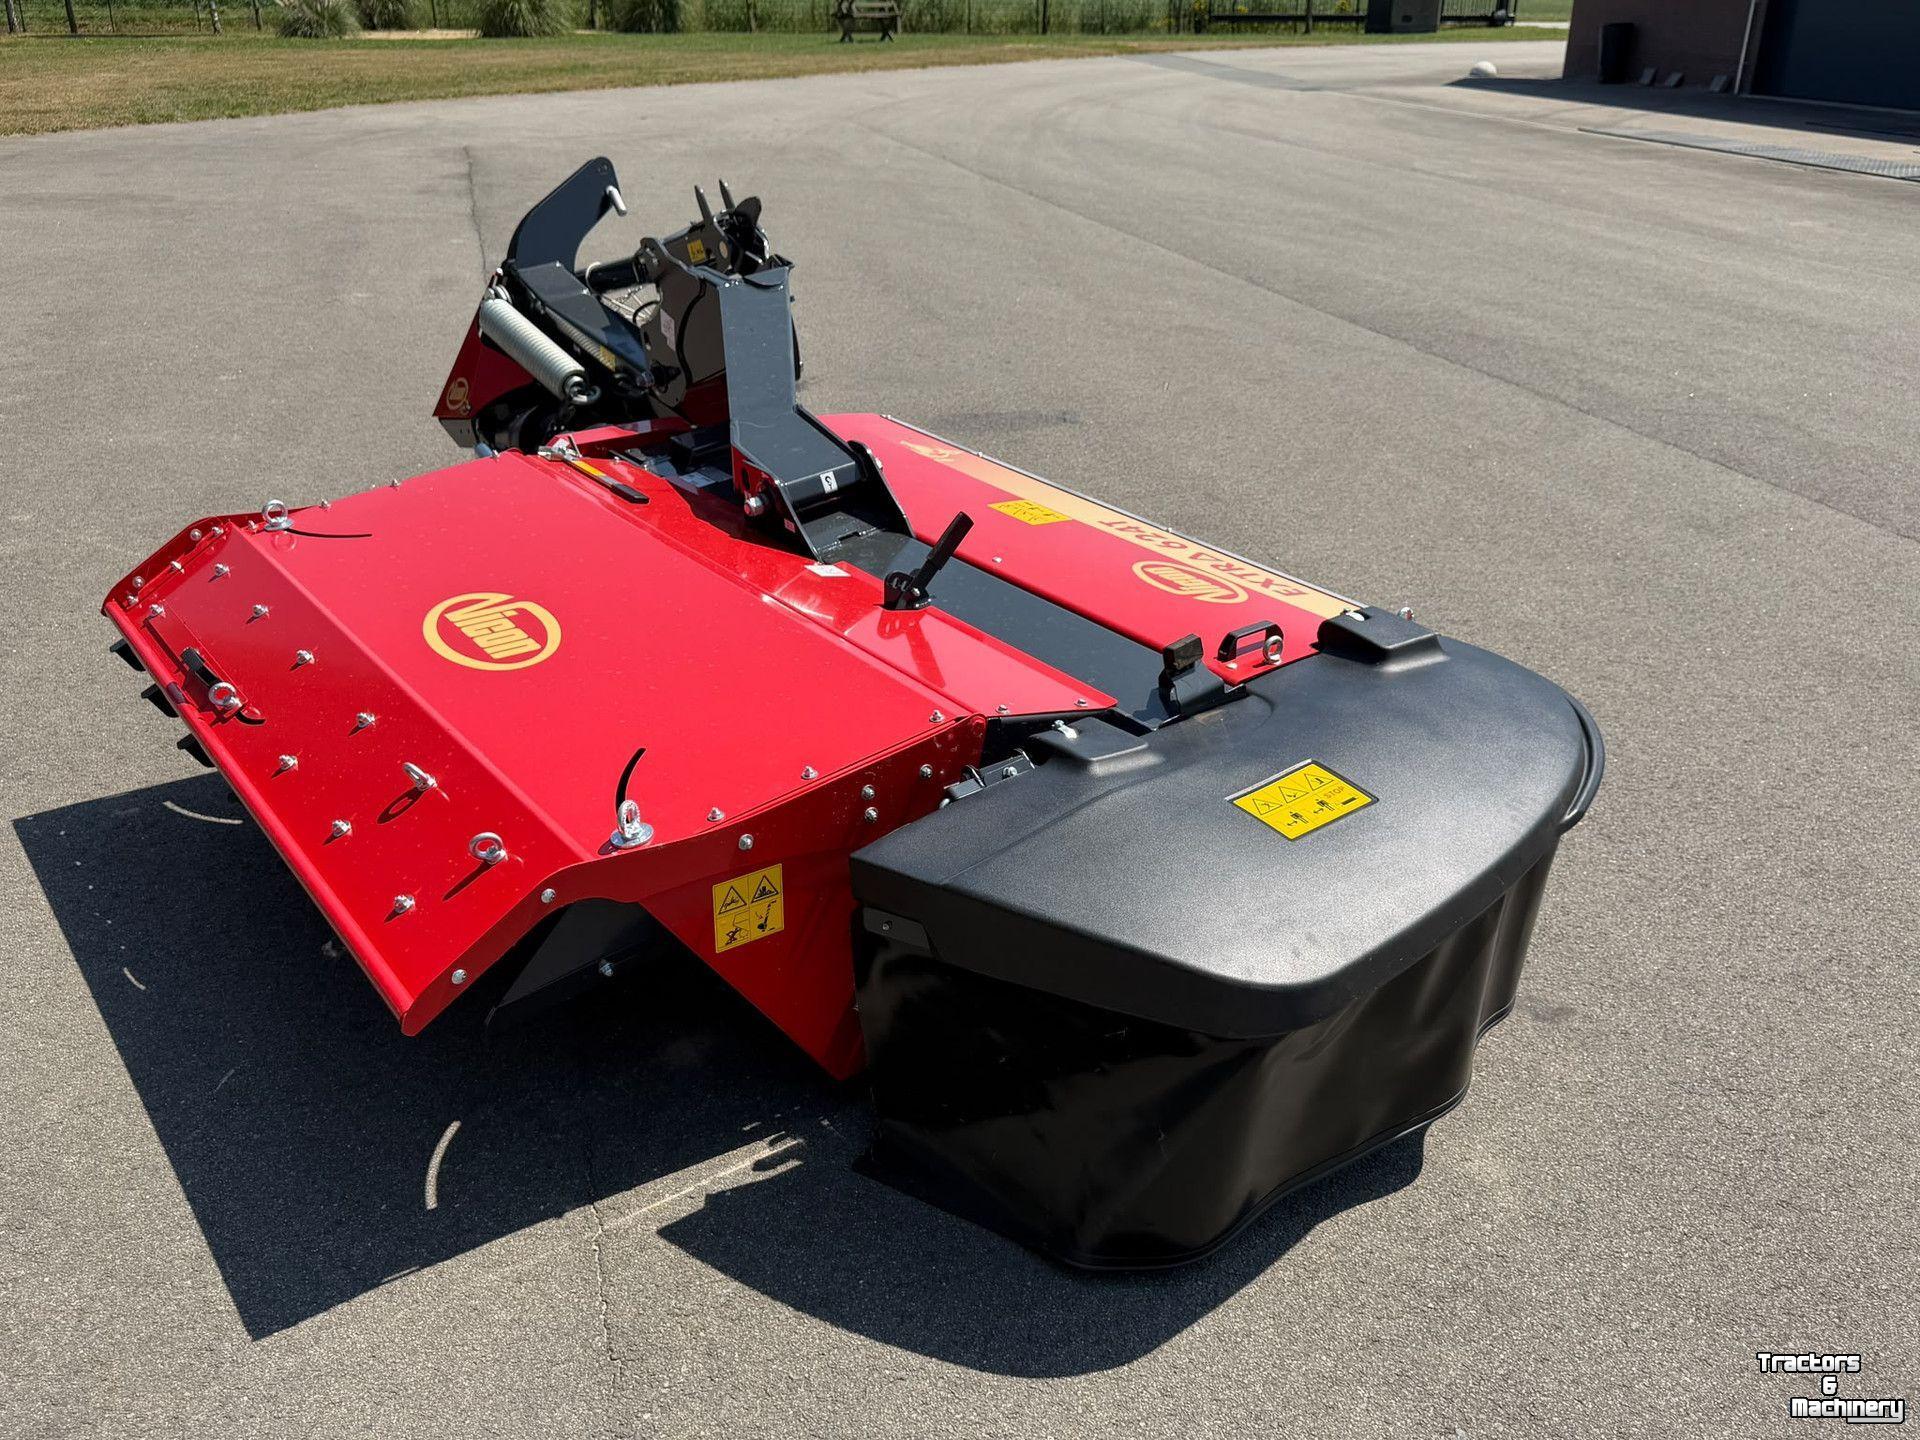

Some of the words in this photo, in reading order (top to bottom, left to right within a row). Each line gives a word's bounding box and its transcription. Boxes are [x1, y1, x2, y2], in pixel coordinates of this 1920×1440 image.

[1097, 520, 1188, 550] 624T
[1188, 551, 1307, 597] EXTRA
[434, 592, 552, 666] Vicon
[1323, 785, 1345, 799] STOP
